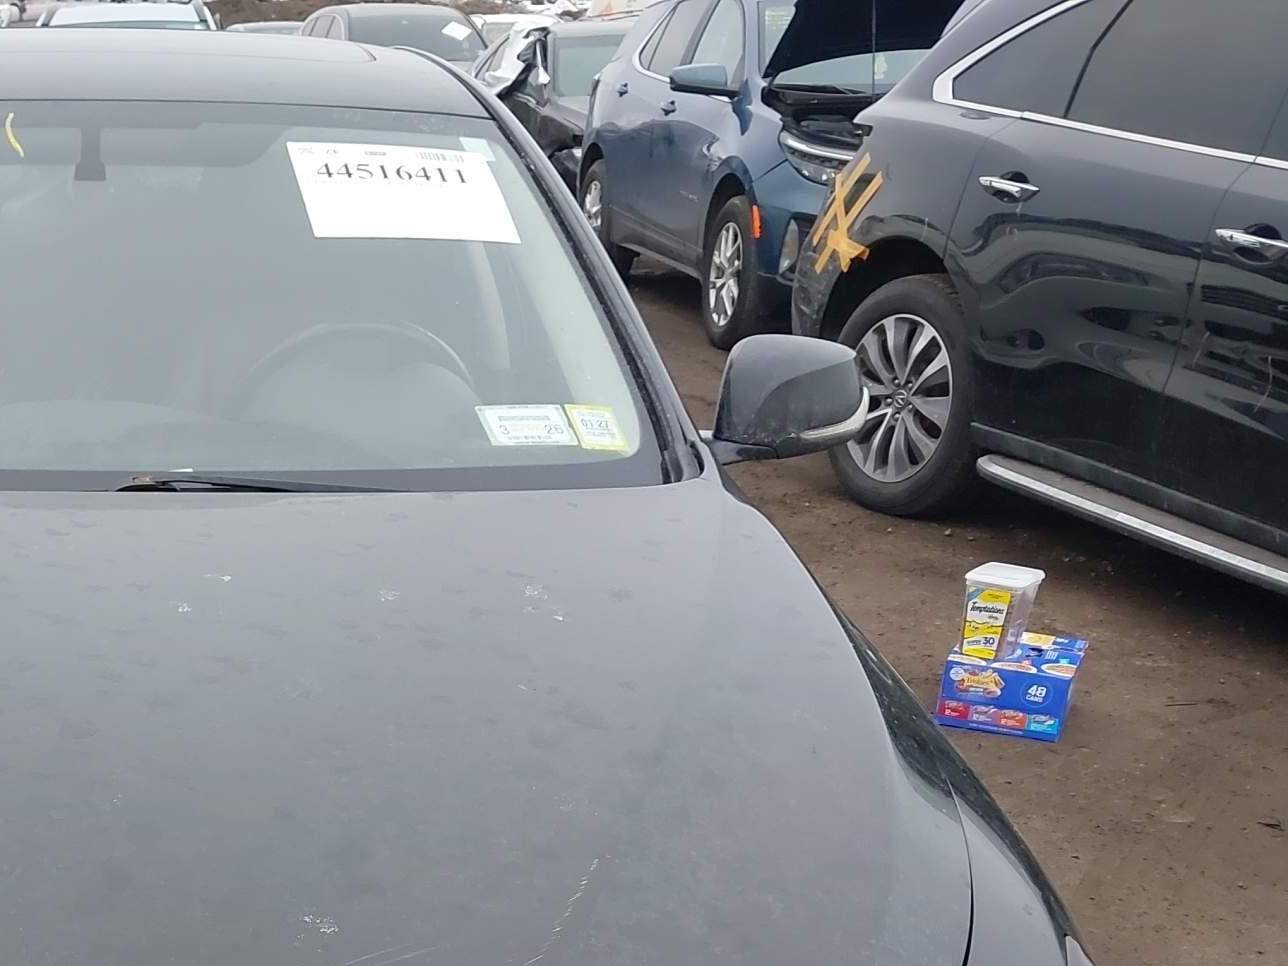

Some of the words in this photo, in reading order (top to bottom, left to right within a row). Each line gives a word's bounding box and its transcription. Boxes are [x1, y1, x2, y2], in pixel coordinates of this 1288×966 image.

[316, 162, 468, 184] 44516411
[982, 636, 995, 645] 30
[1027, 684, 1047, 697] 48
